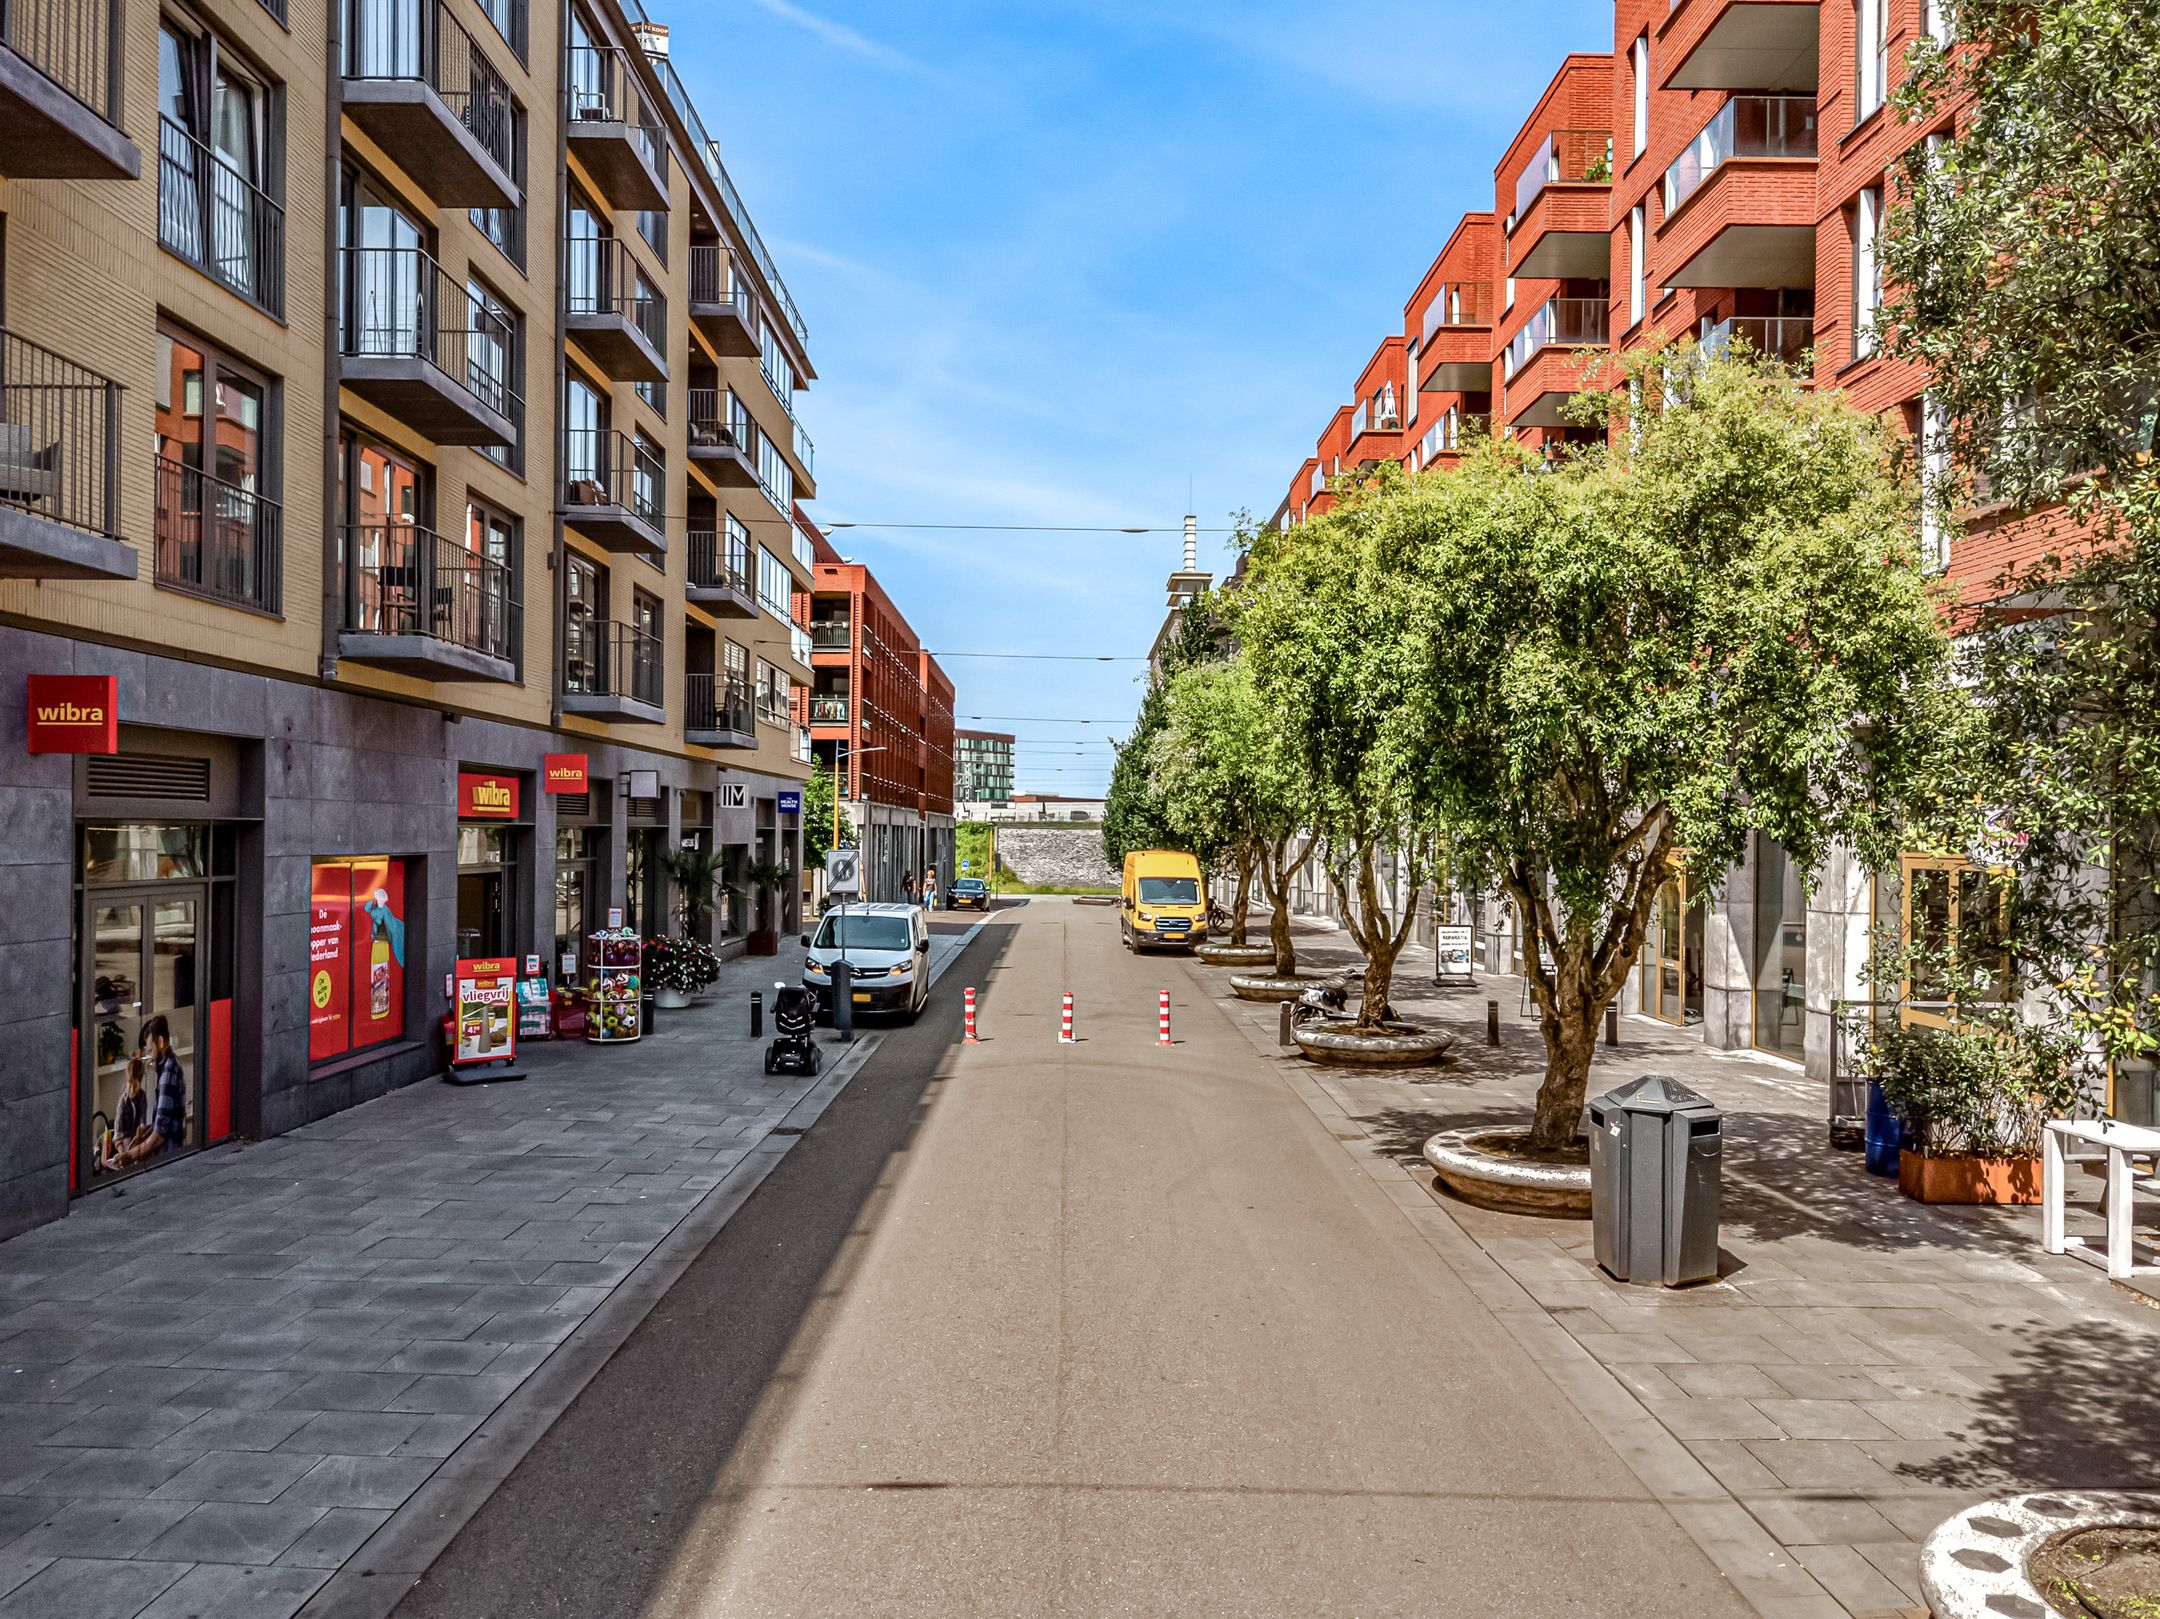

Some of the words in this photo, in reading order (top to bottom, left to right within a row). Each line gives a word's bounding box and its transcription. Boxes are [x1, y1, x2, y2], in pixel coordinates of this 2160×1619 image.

[37, 702, 103, 721] wibra
[549, 768, 583, 777] wibra
[472, 781, 510, 806] wibra
[327, 937, 339, 945] van
[472, 961, 500, 970] wibra
[462, 987, 510, 1002] vliegvrij
